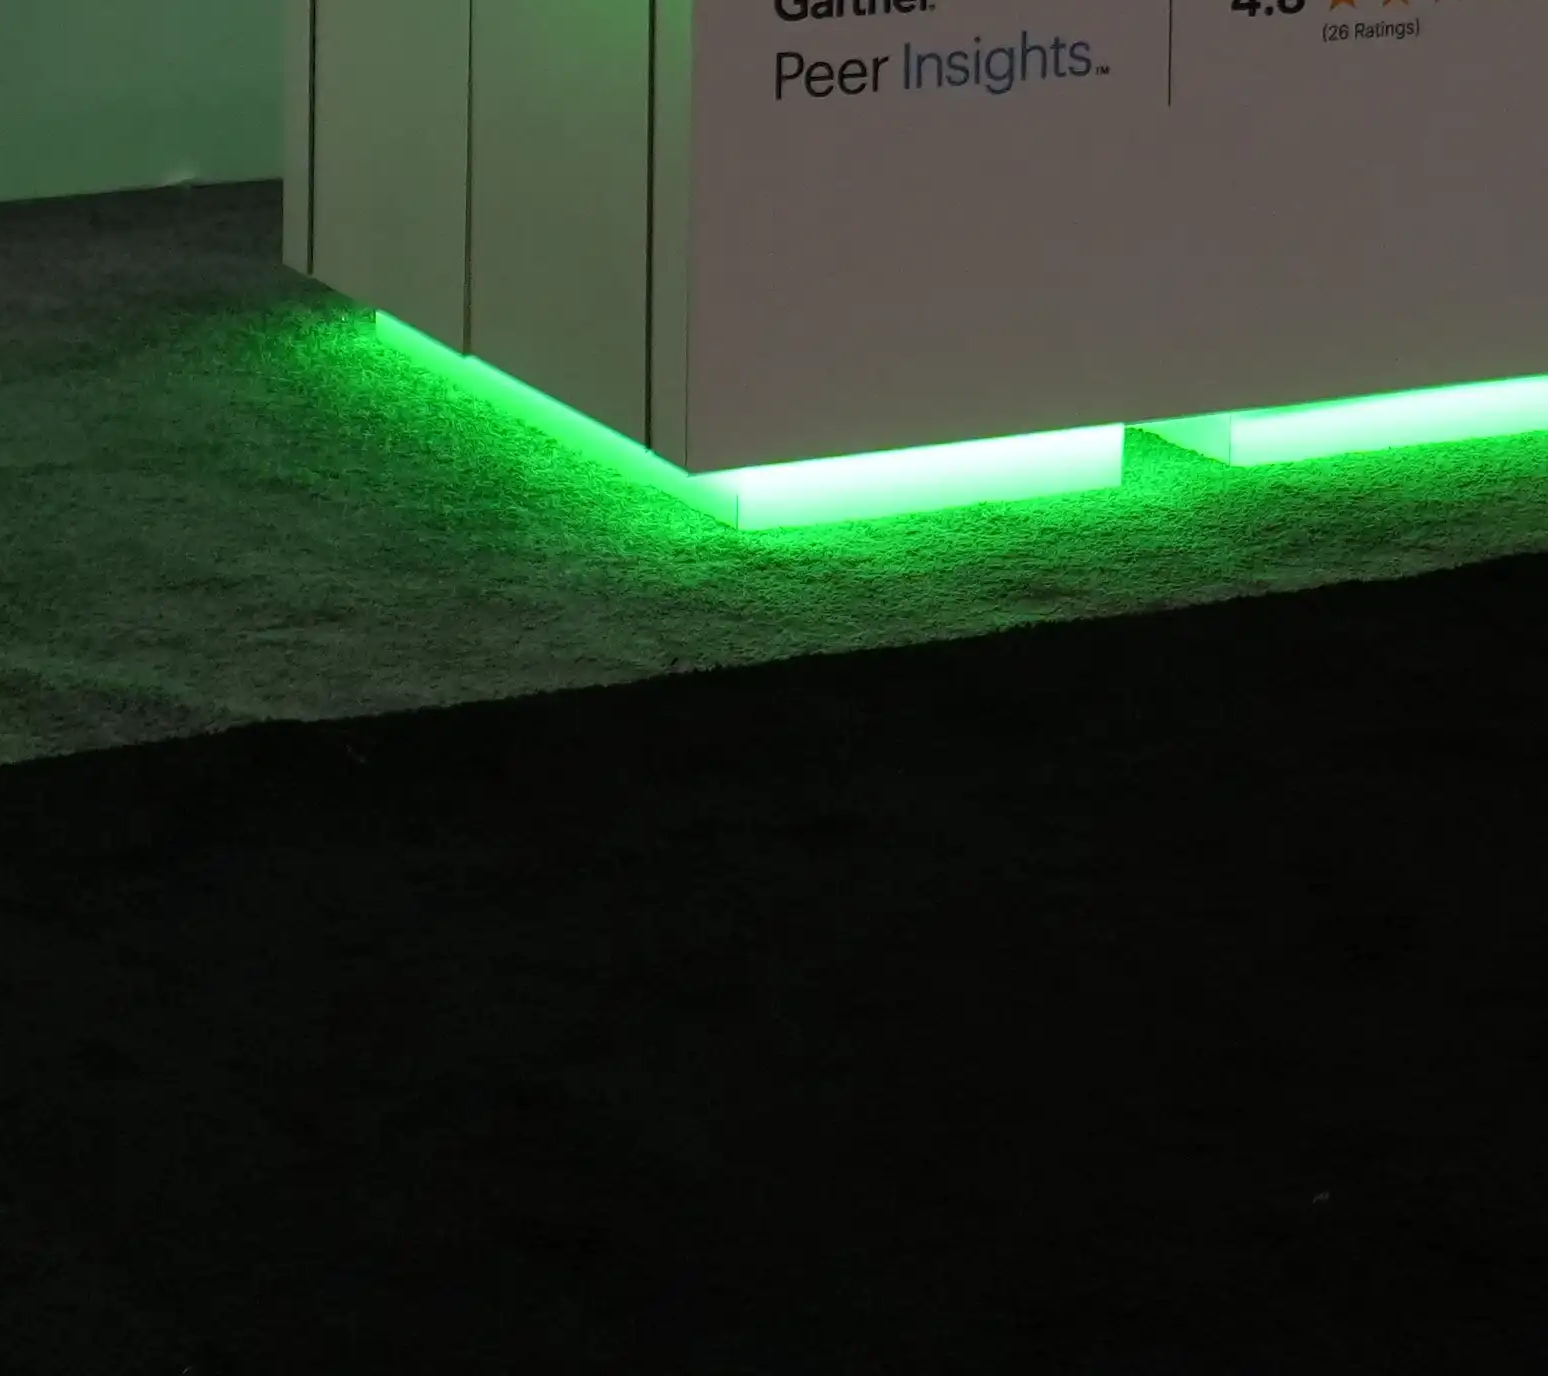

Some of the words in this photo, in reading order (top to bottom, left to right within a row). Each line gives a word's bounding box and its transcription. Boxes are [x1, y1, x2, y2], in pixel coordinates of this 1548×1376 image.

[1321, 22, 1350, 43] (26
[1354, 17, 1420, 40] Ratings)
[774, 47, 890, 101] Peer
